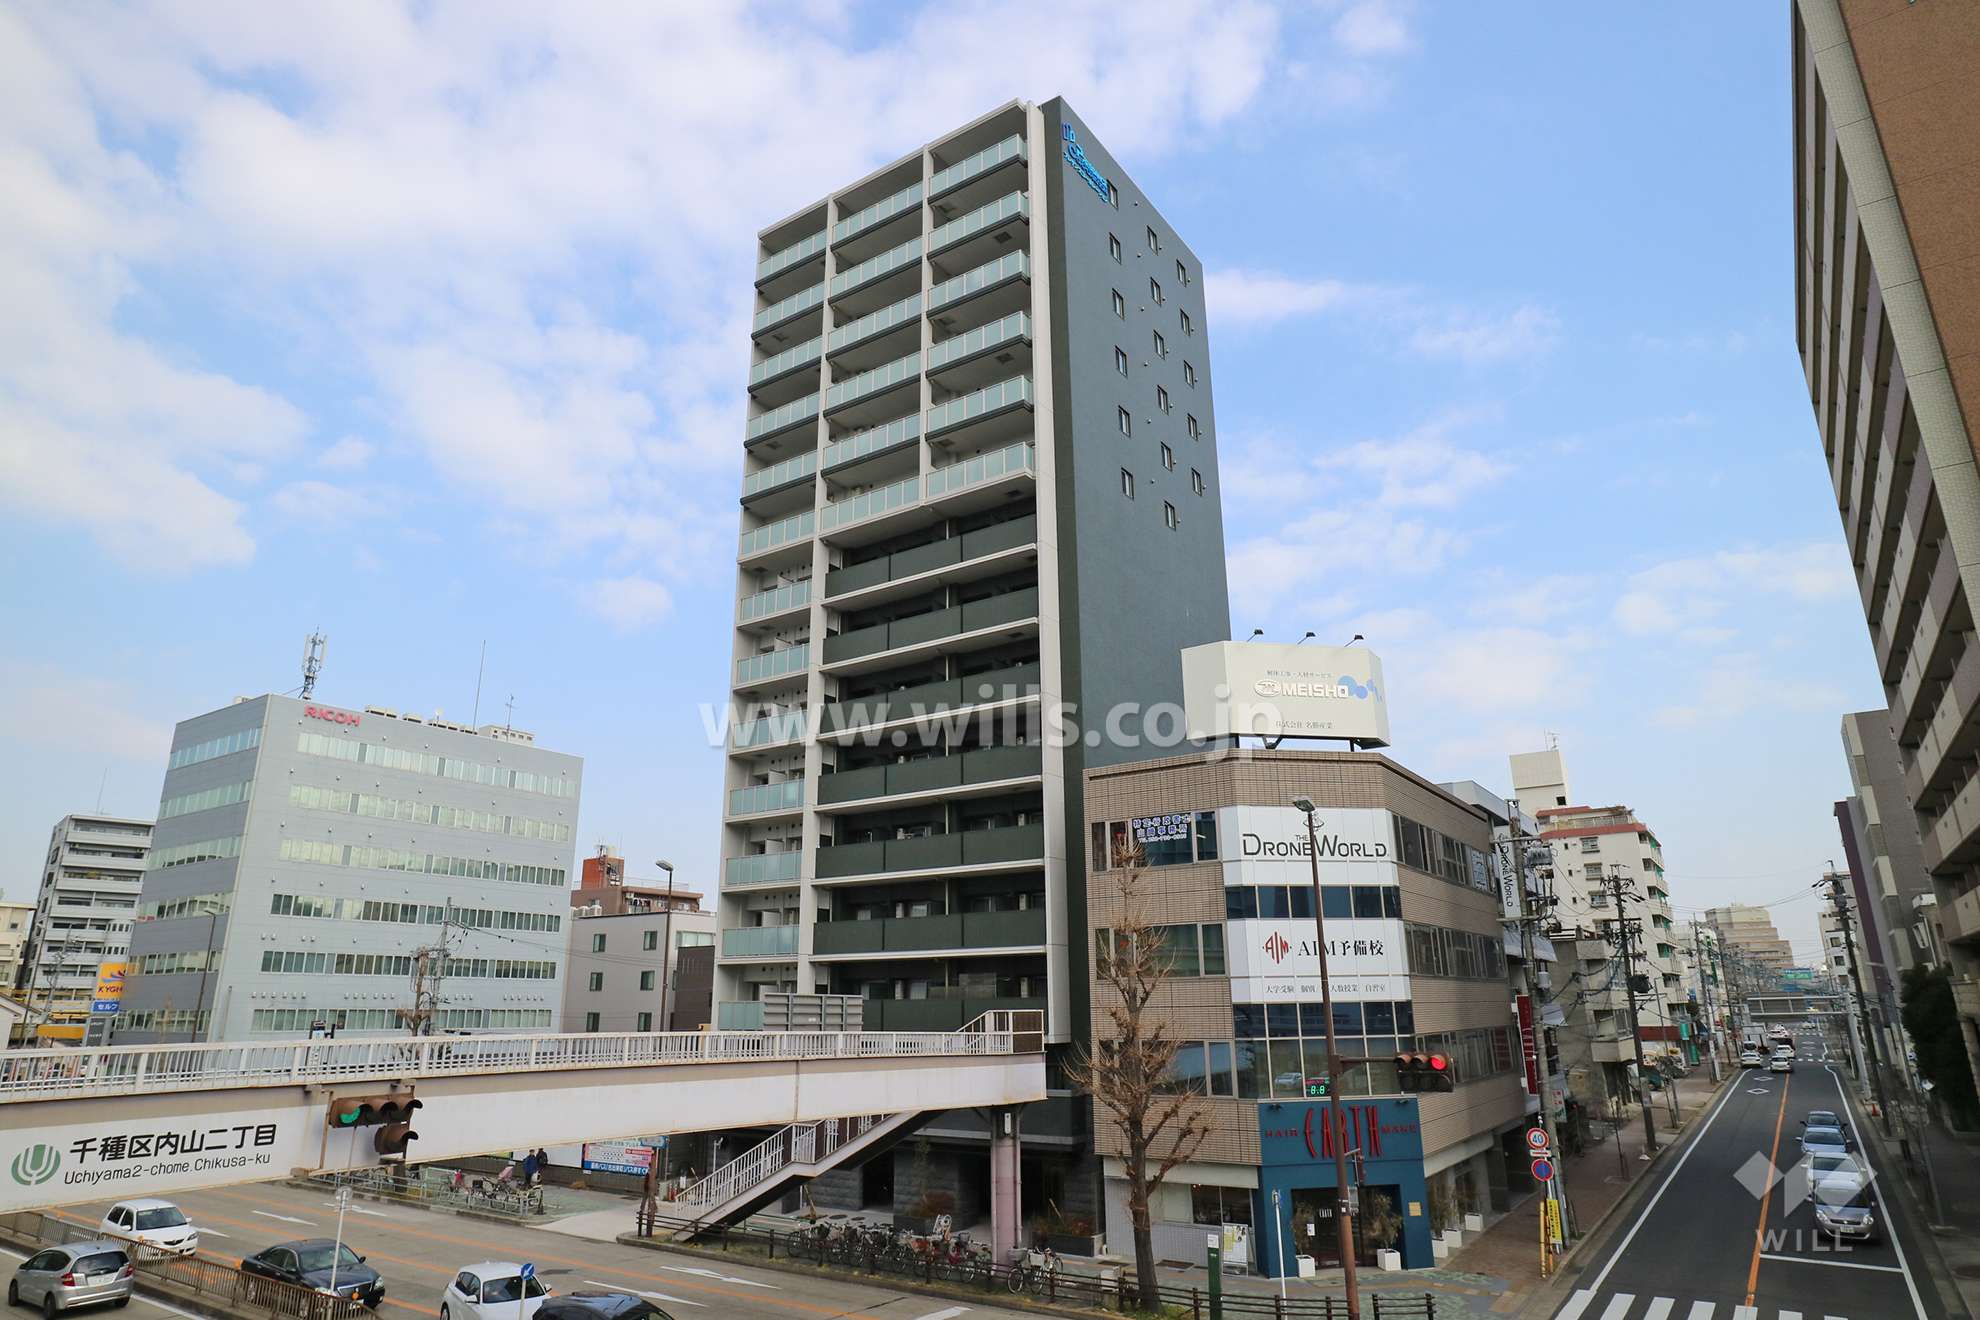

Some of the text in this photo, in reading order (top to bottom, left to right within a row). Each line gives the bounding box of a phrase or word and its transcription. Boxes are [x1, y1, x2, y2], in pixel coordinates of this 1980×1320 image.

[1282, 682, 1349, 699] MEISHO
[304, 704, 361, 728] RICOH
[1242, 833, 1388, 857] DRONE WORLD
[1295, 834, 1309, 842] THE
[97, 1002, 118, 1011] セルフ
[70, 1123, 277, 1164] 千種区内山二丁目
